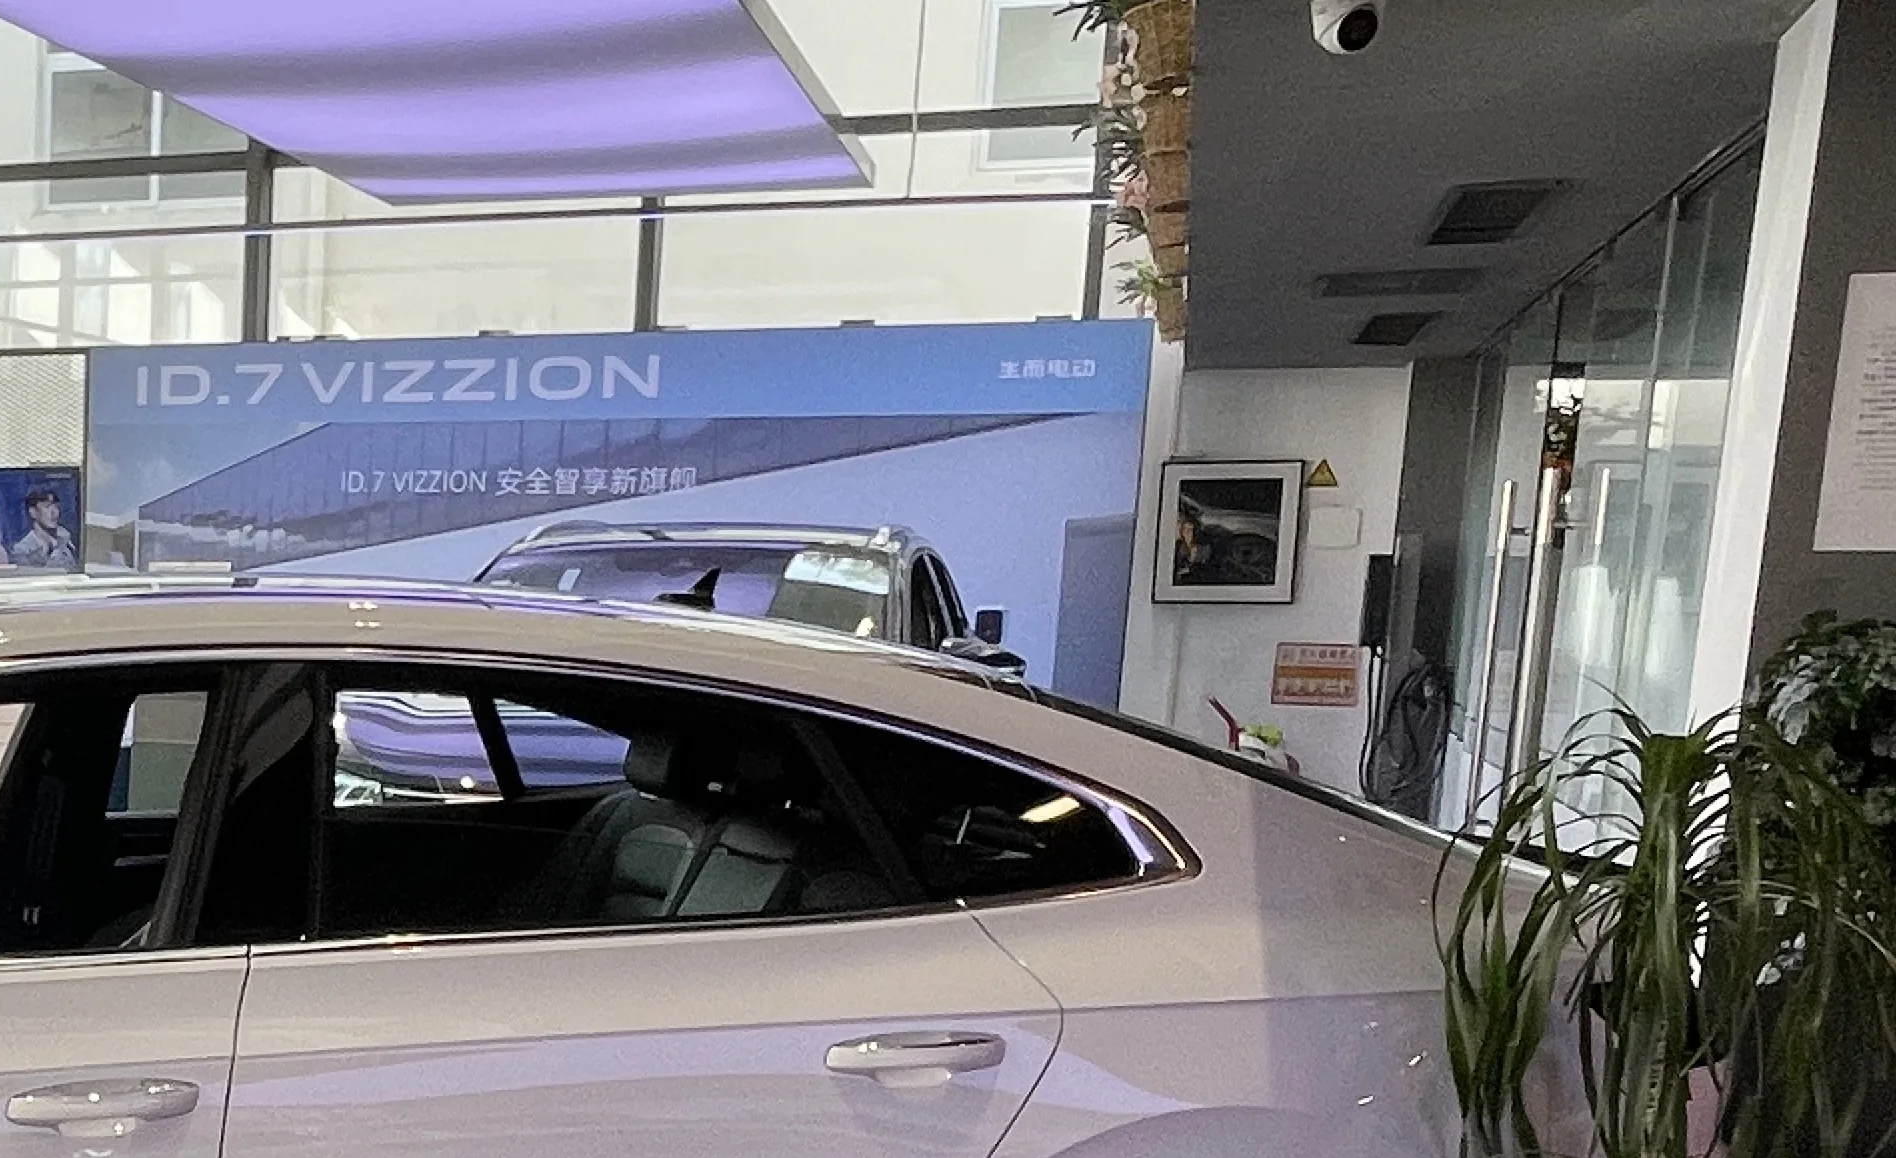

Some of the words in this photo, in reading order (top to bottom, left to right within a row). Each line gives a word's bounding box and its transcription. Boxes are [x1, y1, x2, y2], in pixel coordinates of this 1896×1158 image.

[136, 363, 284, 406] ID.7
[300, 355, 661, 404] VIZZION
[339, 470, 384, 494] ID.7
[391, 469, 489, 494] VIZZION
[494, 466, 698, 497] 安全智享新旗舰
